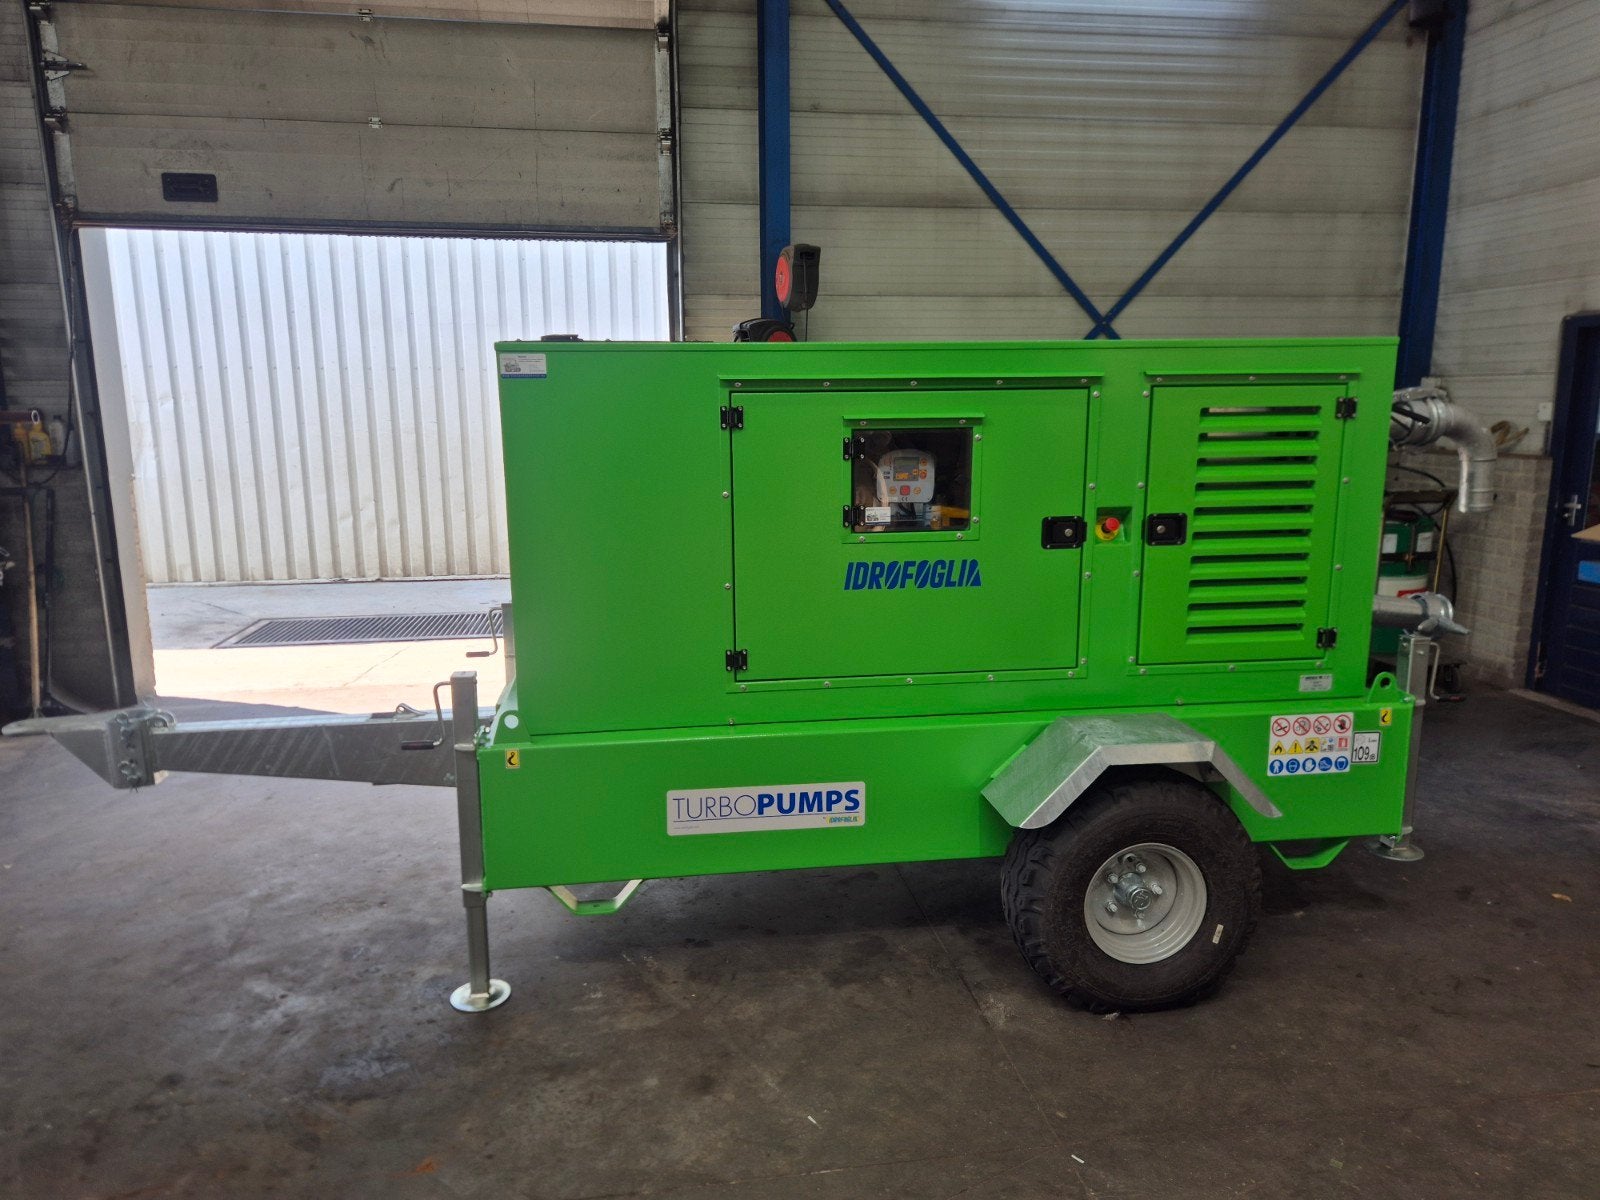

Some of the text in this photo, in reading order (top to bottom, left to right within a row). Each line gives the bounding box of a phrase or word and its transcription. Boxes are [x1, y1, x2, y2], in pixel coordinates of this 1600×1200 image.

[844, 558, 981, 591] IDROFOGLIA
[1353, 745, 1370, 761] 109
[672, 789, 860, 820] TURBOPUMPS
